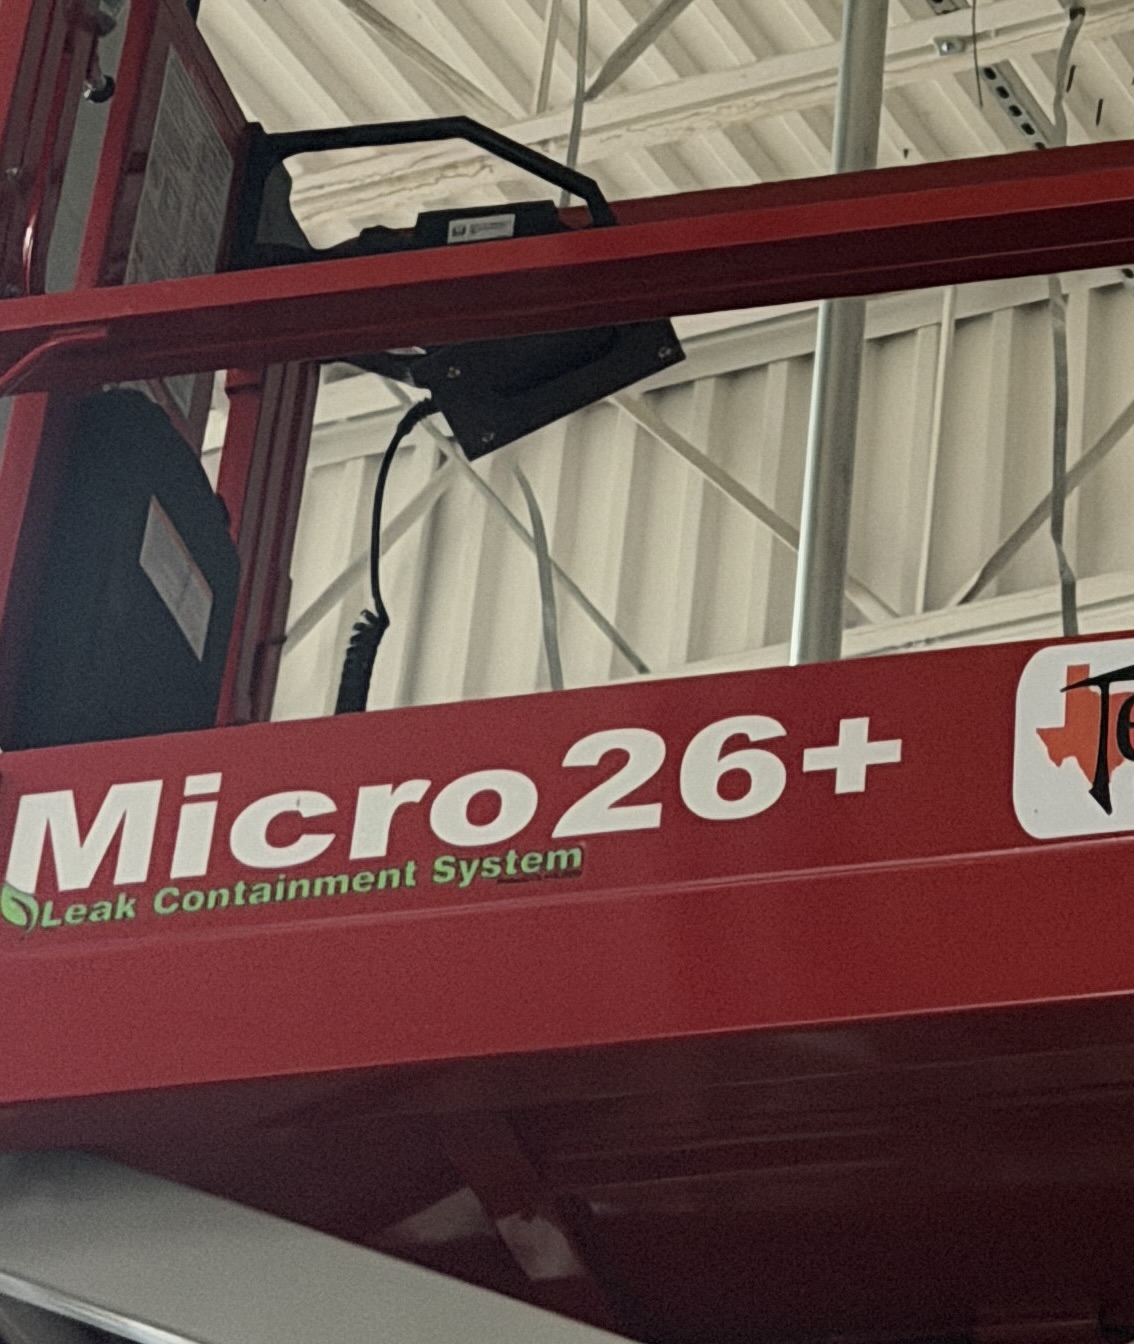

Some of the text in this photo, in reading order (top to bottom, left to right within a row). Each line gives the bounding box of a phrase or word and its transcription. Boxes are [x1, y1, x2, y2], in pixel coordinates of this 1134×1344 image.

[41, 848, 583, 928] Leak Containment System
